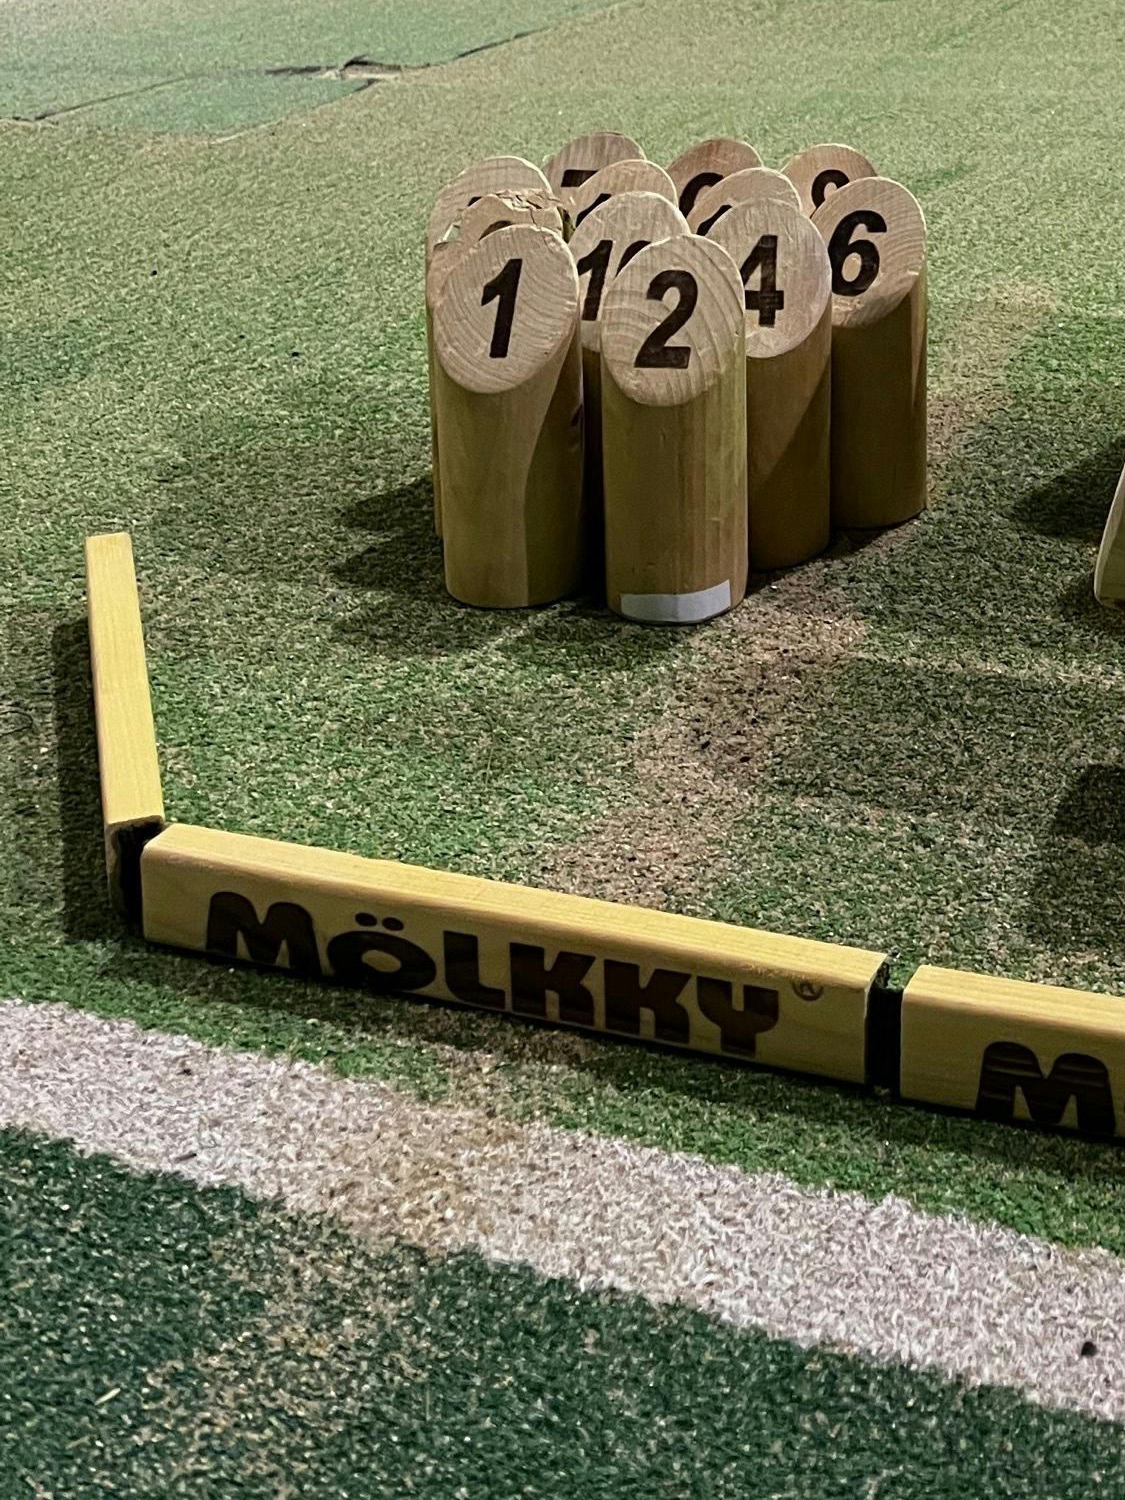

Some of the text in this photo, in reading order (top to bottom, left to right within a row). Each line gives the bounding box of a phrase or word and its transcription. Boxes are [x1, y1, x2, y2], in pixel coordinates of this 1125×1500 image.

[740, 235, 784, 328] 4
[828, 210, 887, 297] 6
[481, 259, 523, 358] 1
[634, 270, 698, 369] 2
